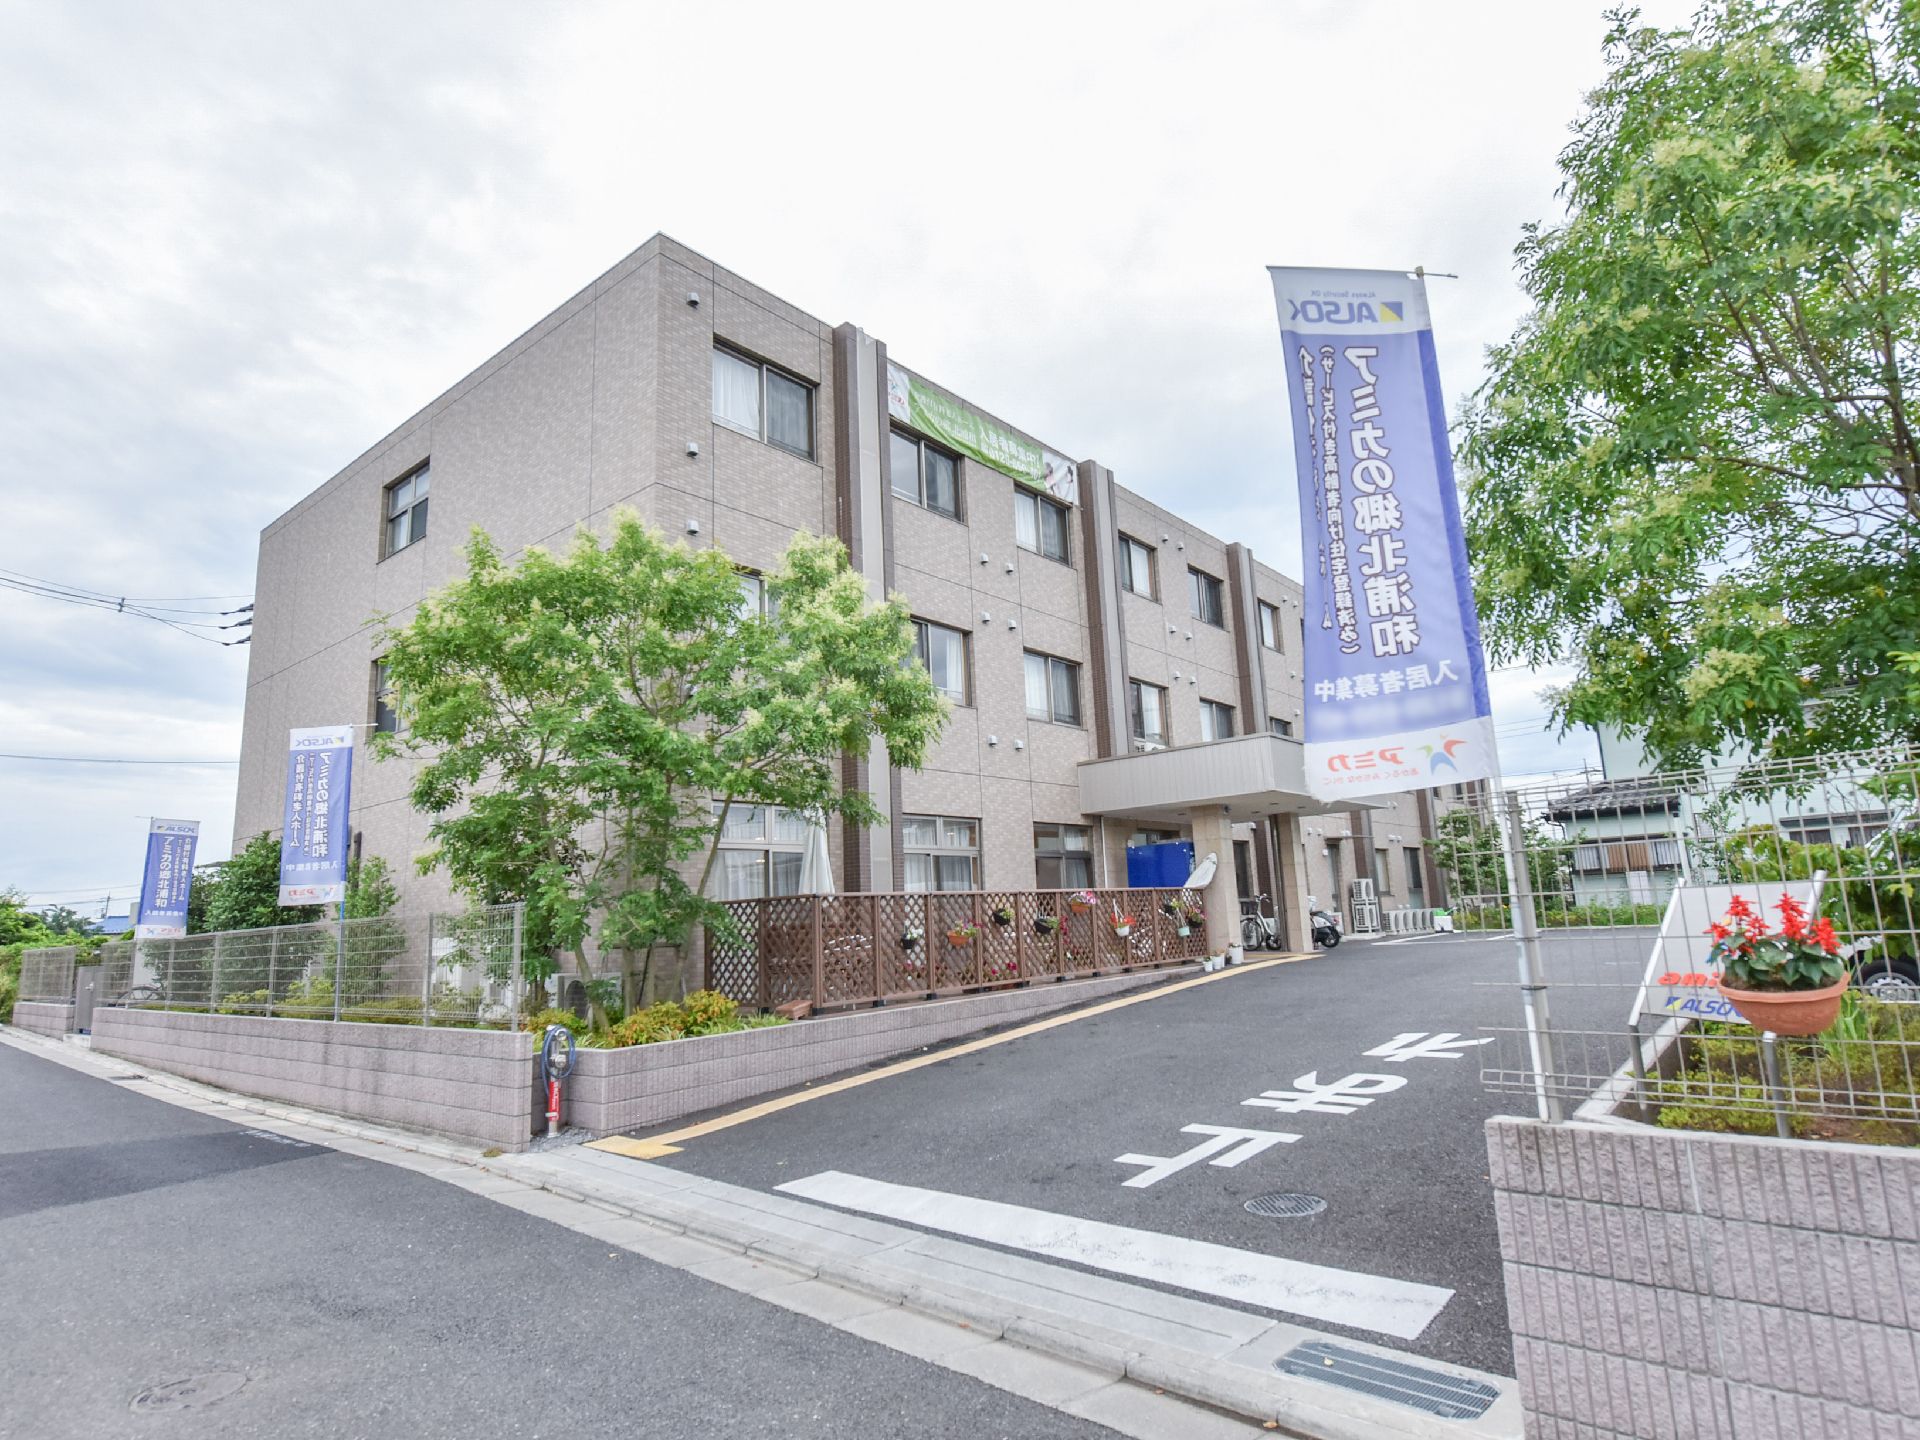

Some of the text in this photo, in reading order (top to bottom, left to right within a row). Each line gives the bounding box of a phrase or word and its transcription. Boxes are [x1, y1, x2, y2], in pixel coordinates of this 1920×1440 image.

[155, 836, 175, 908] アミカの郷北浦和
[1659, 972, 1718, 987] ami
[1113, 1032, 1496, 1188] 止まれ
